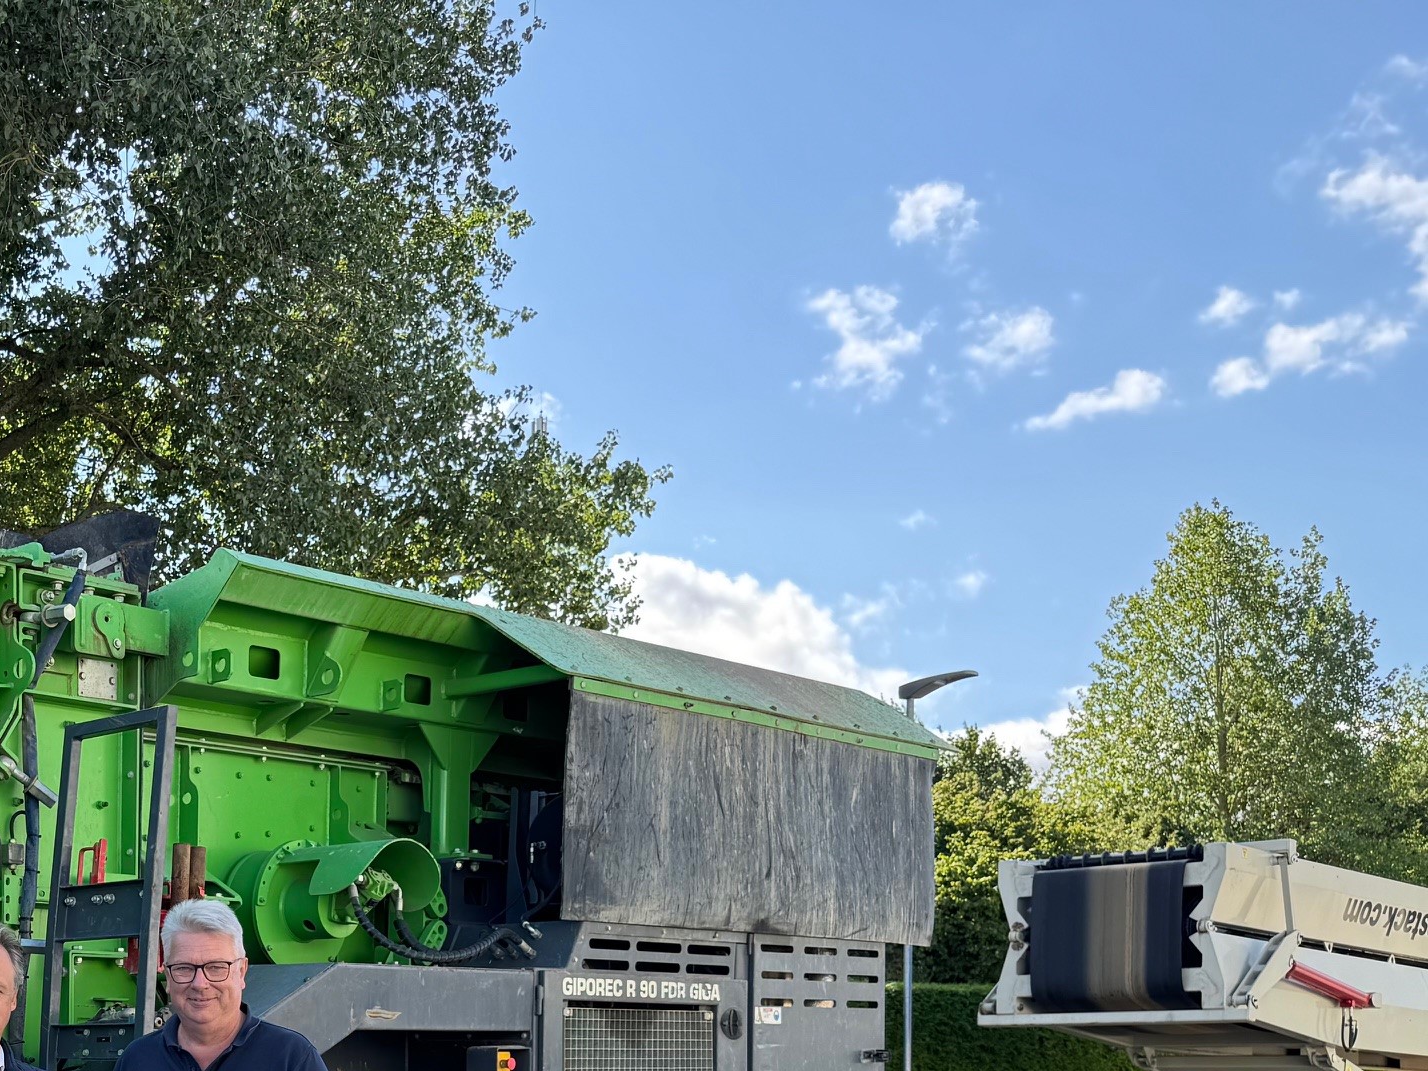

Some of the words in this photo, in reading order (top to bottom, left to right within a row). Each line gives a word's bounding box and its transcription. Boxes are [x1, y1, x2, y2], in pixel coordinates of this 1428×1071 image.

[562, 977, 623, 997] GIPOREC
[626, 979, 636, 998] R
[639, 980, 658, 999] 90
[661, 981, 686, 999] FDR
